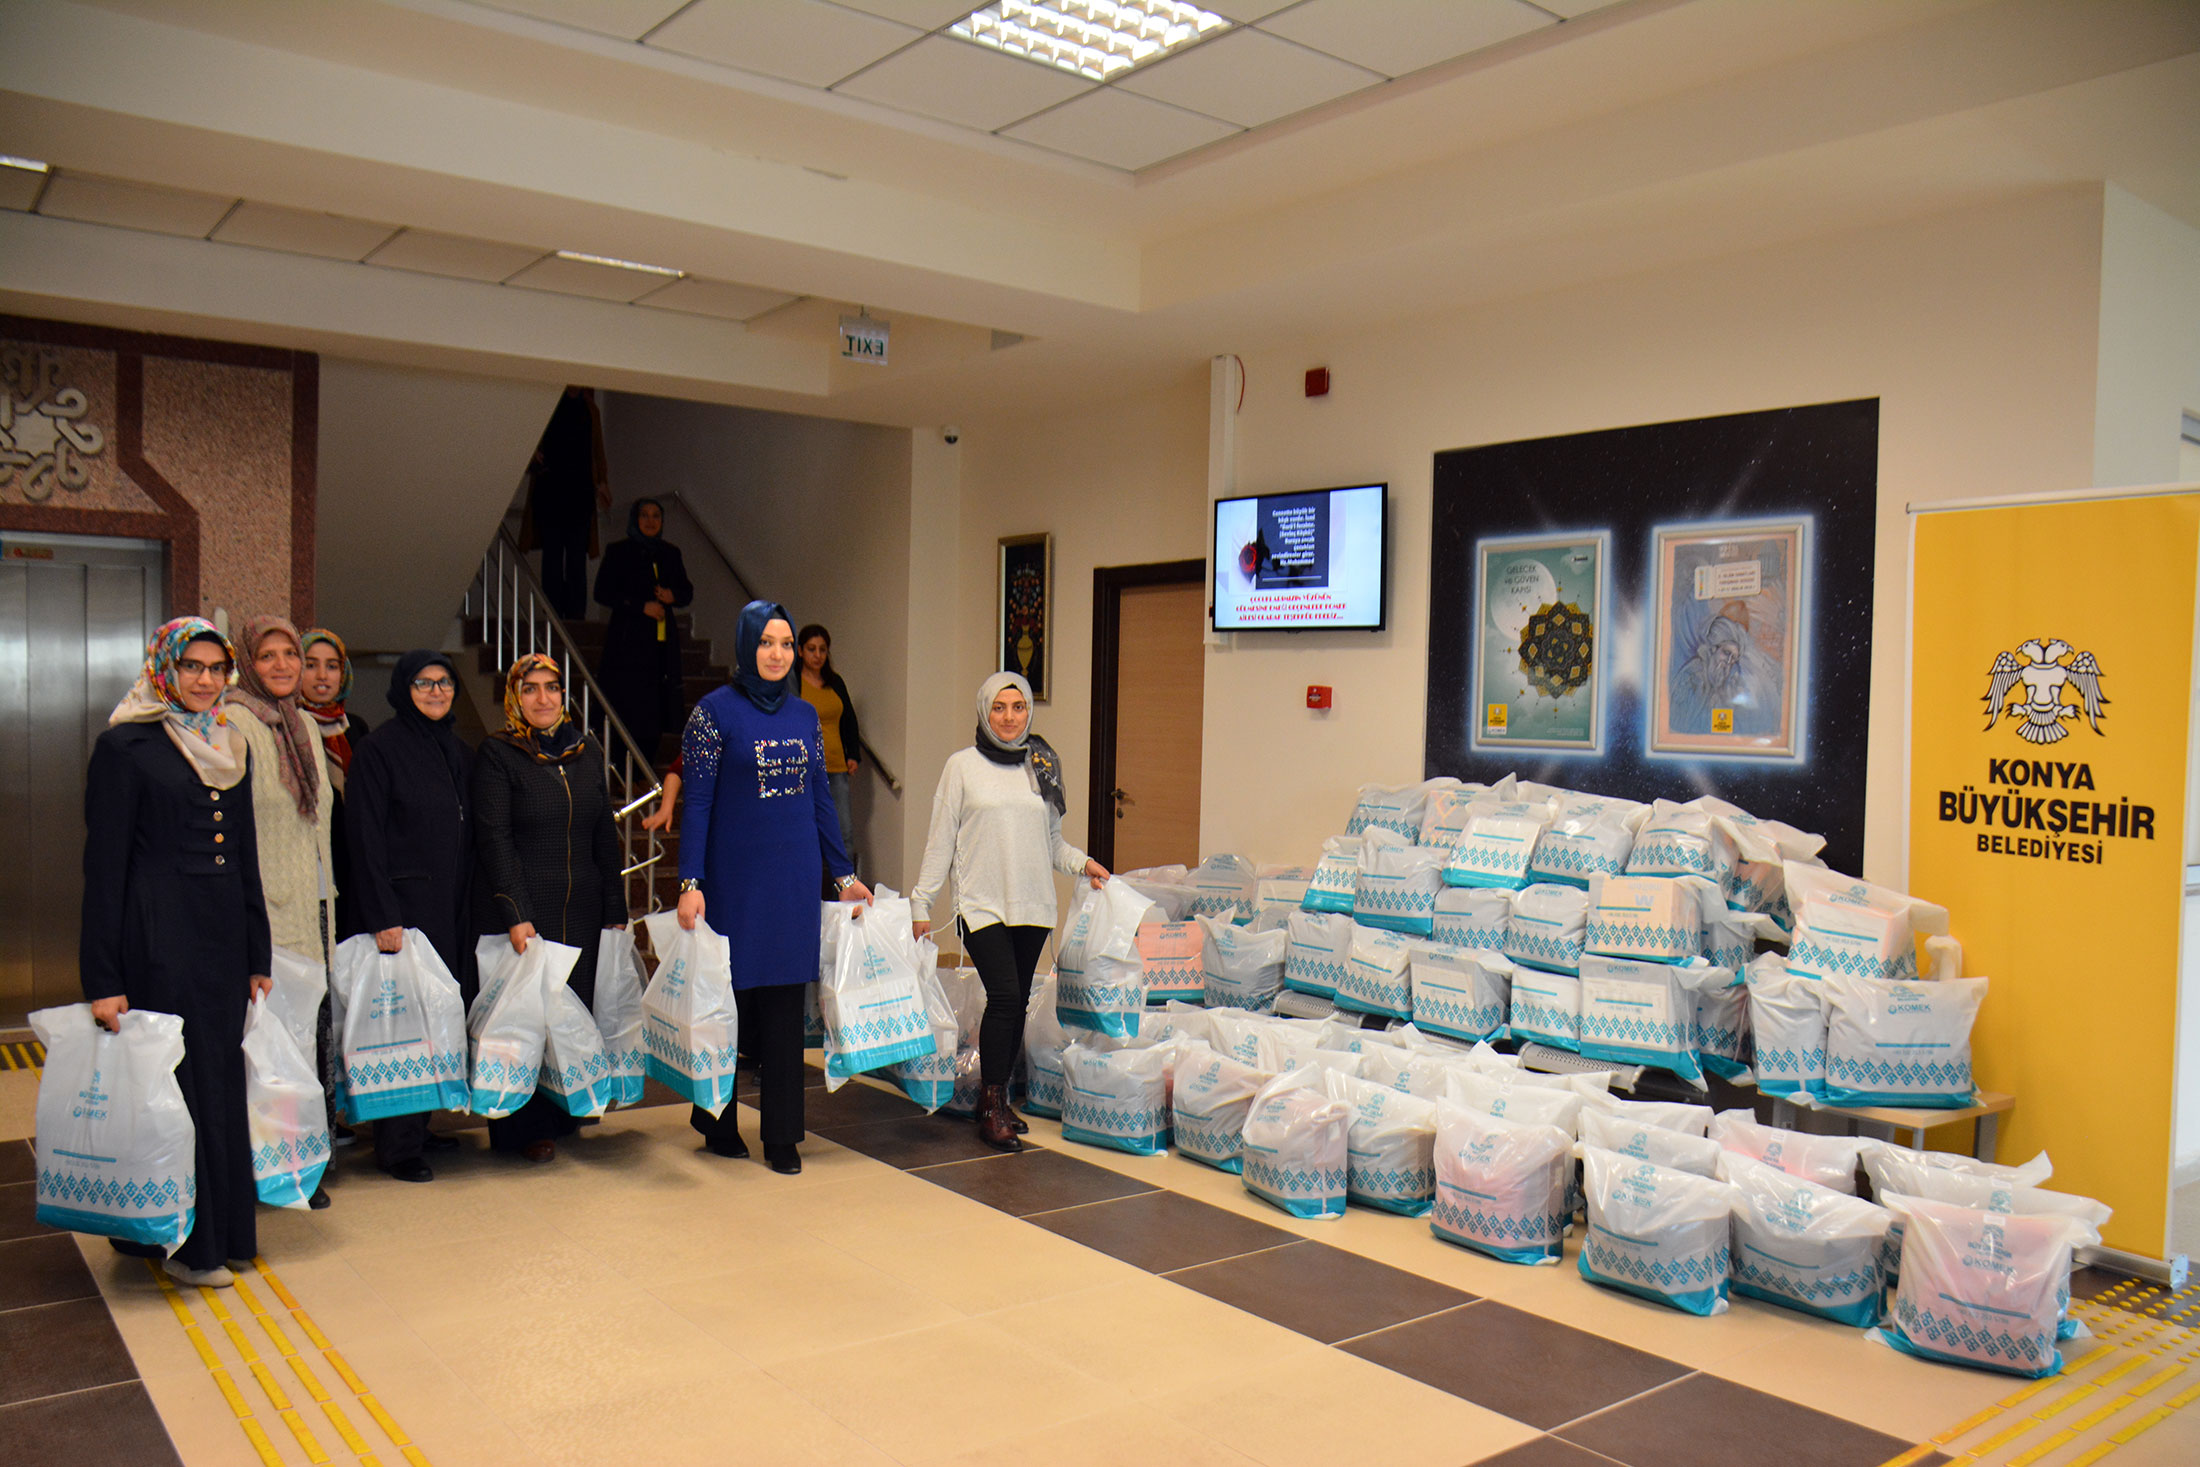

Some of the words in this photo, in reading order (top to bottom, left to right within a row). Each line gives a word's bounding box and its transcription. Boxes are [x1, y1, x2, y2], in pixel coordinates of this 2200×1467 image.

[1506, 565, 1537, 575] GELECEK
[1514, 574, 1540, 585] GÜVEN
[1989, 758, 2095, 791] KONYA
[1939, 785, 2155, 840] BÜYÜKŞEHİR
[1977, 834, 2103, 865] BELEDİYESİ
[1613, 965, 1641, 975] KOMEK
[1896, 1003, 1931, 1014] KOMEK
